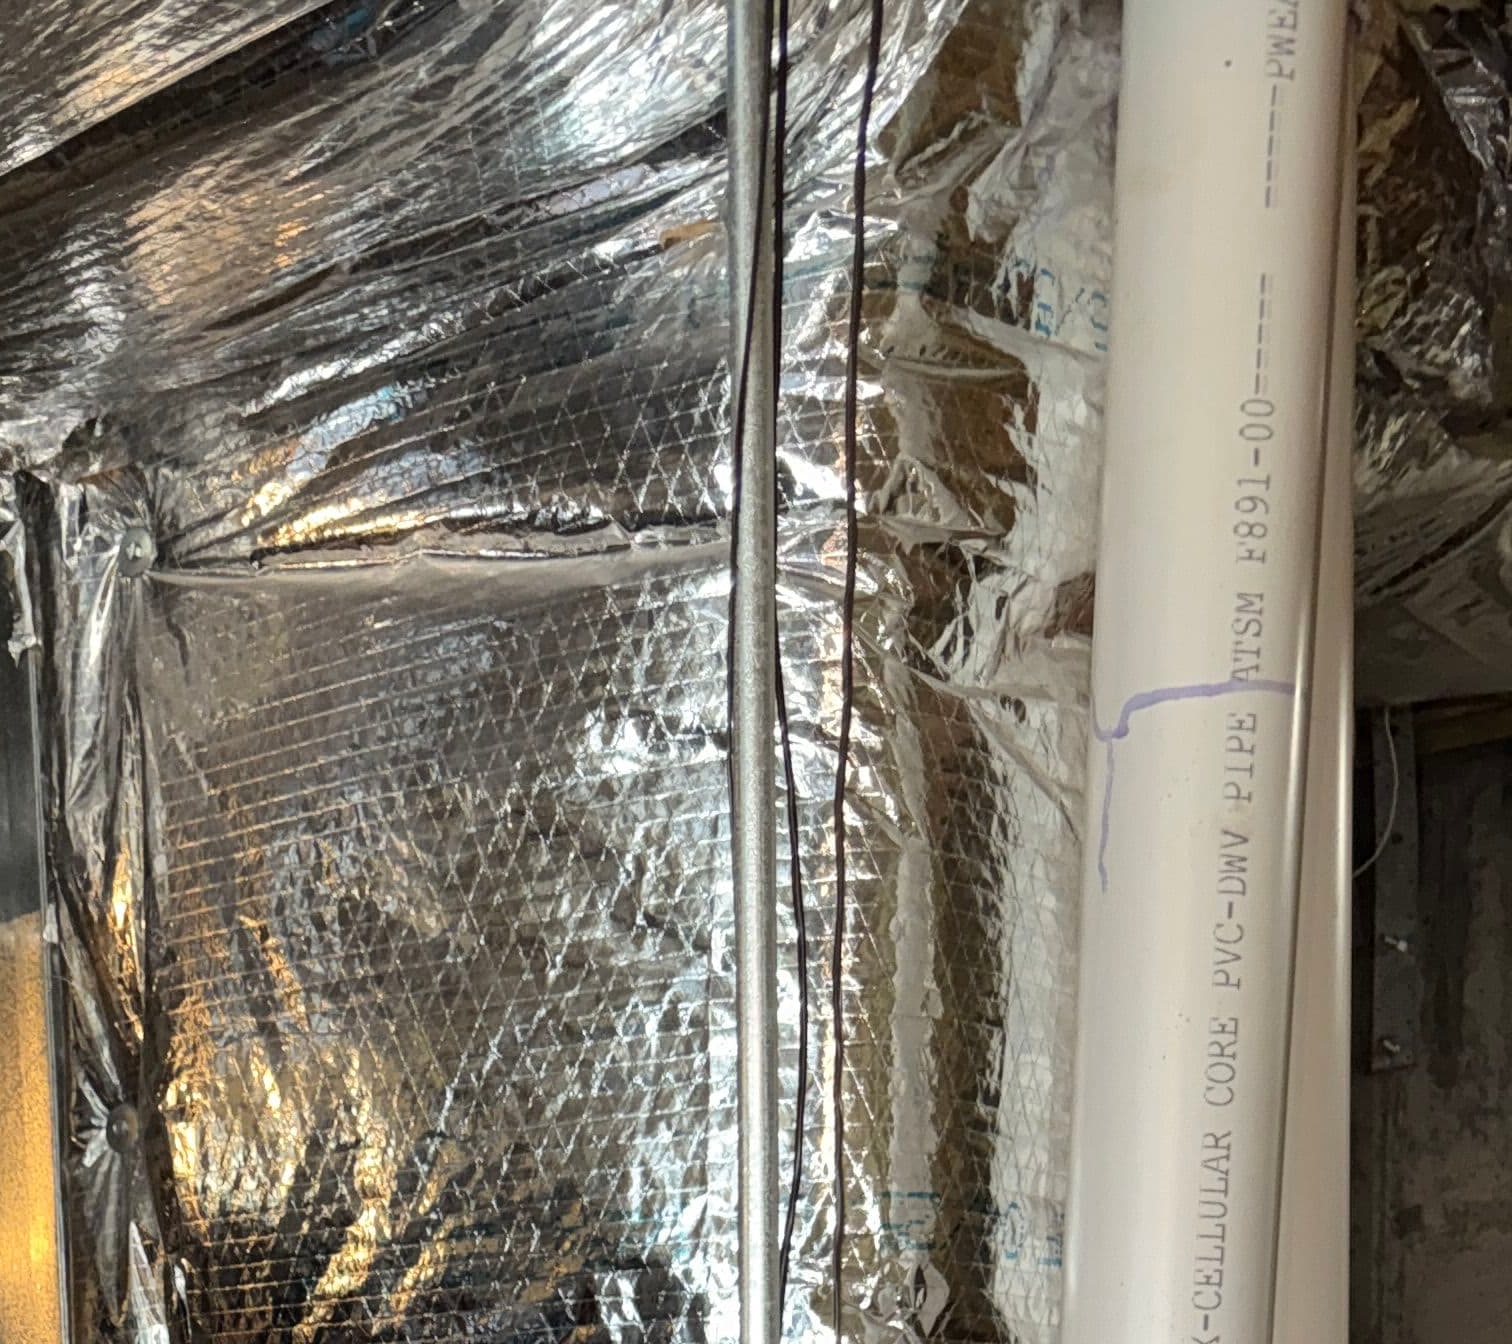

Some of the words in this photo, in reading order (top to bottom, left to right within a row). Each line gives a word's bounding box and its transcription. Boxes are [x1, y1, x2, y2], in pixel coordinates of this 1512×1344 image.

[1263, 0, 1298, 81] PWE
[1230, 592, 1265, 684] ATSM
[1223, 712, 1257, 804] PIPE
[1213, 830, 1250, 991] PVC-DWV
[1204, 1017, 1238, 1107] CORE
